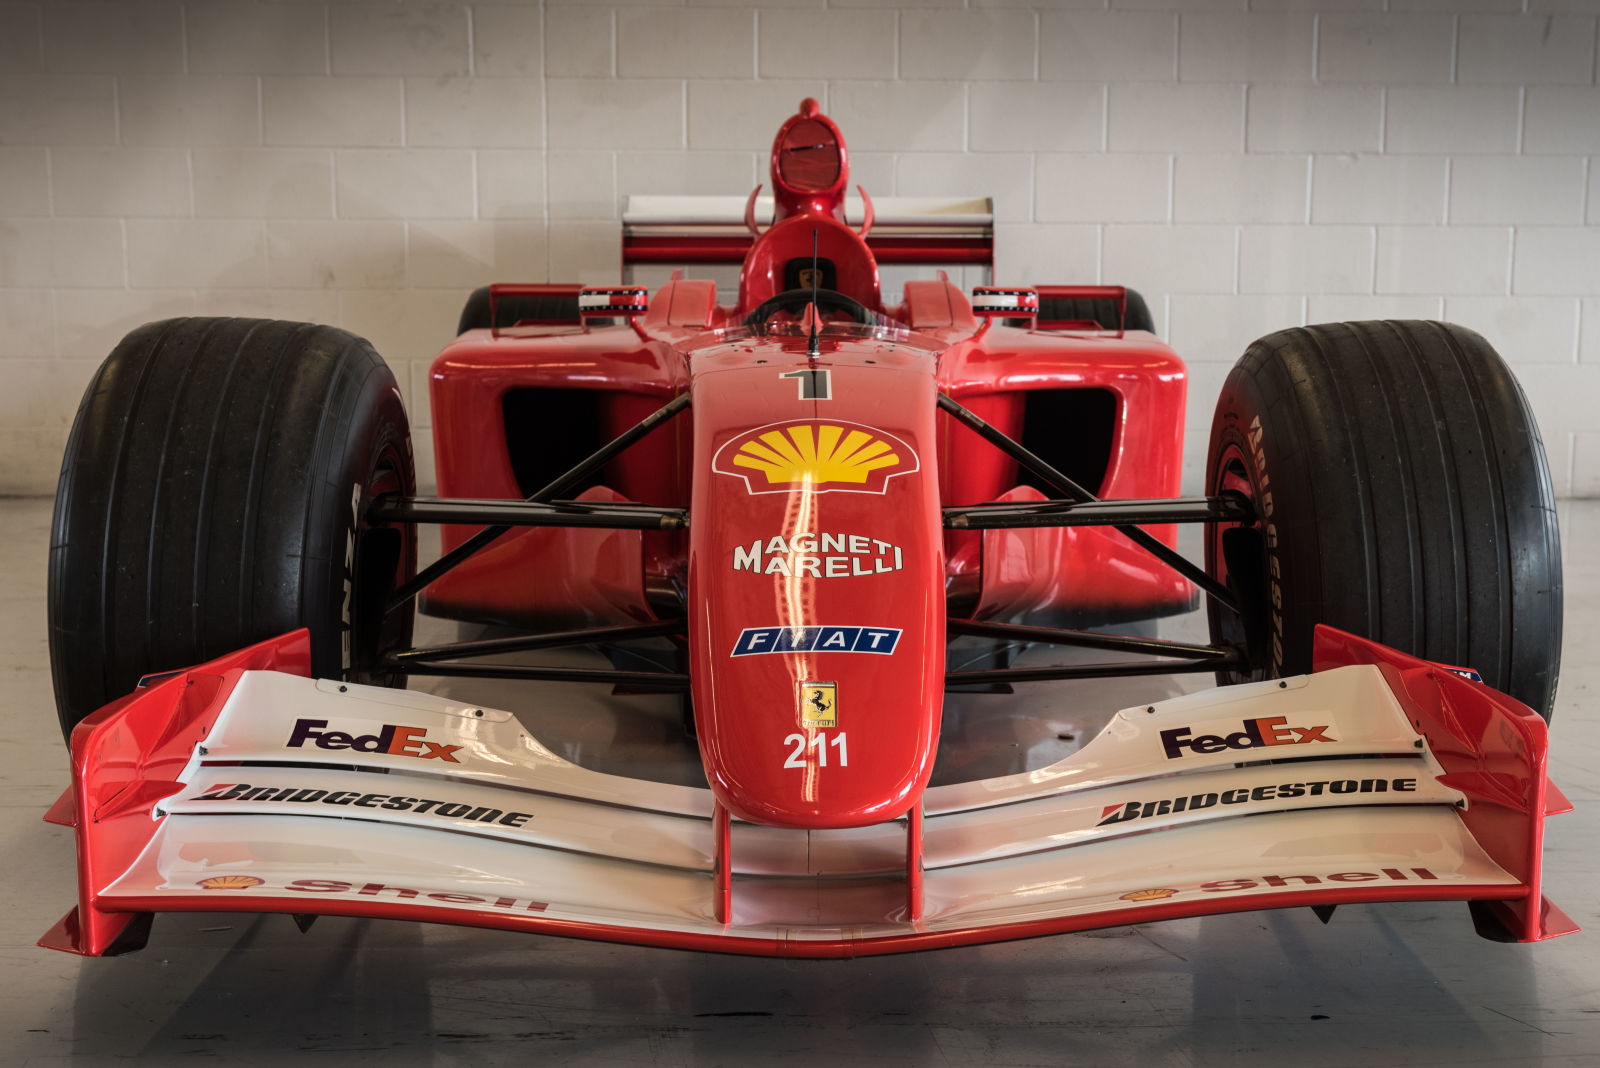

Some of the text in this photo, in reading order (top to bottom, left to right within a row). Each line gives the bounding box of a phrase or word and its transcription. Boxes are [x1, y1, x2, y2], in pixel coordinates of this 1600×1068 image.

[779, 369, 832, 400] 1
[733, 532, 903, 564] MAGNETI
[733, 545, 903, 578] MARELLI
[746, 631, 889, 650] FIAT
[286, 718, 464, 763] FedEx
[783, 732, 848, 769] 211
[1159, 716, 1338, 759] FedEx
[190, 783, 534, 827] BRIDGESTONE
[1096, 778, 1417, 826] BRIDGESTONE
[284, 879, 549, 912] Shell
[1200, 868, 1439, 893] Shell
